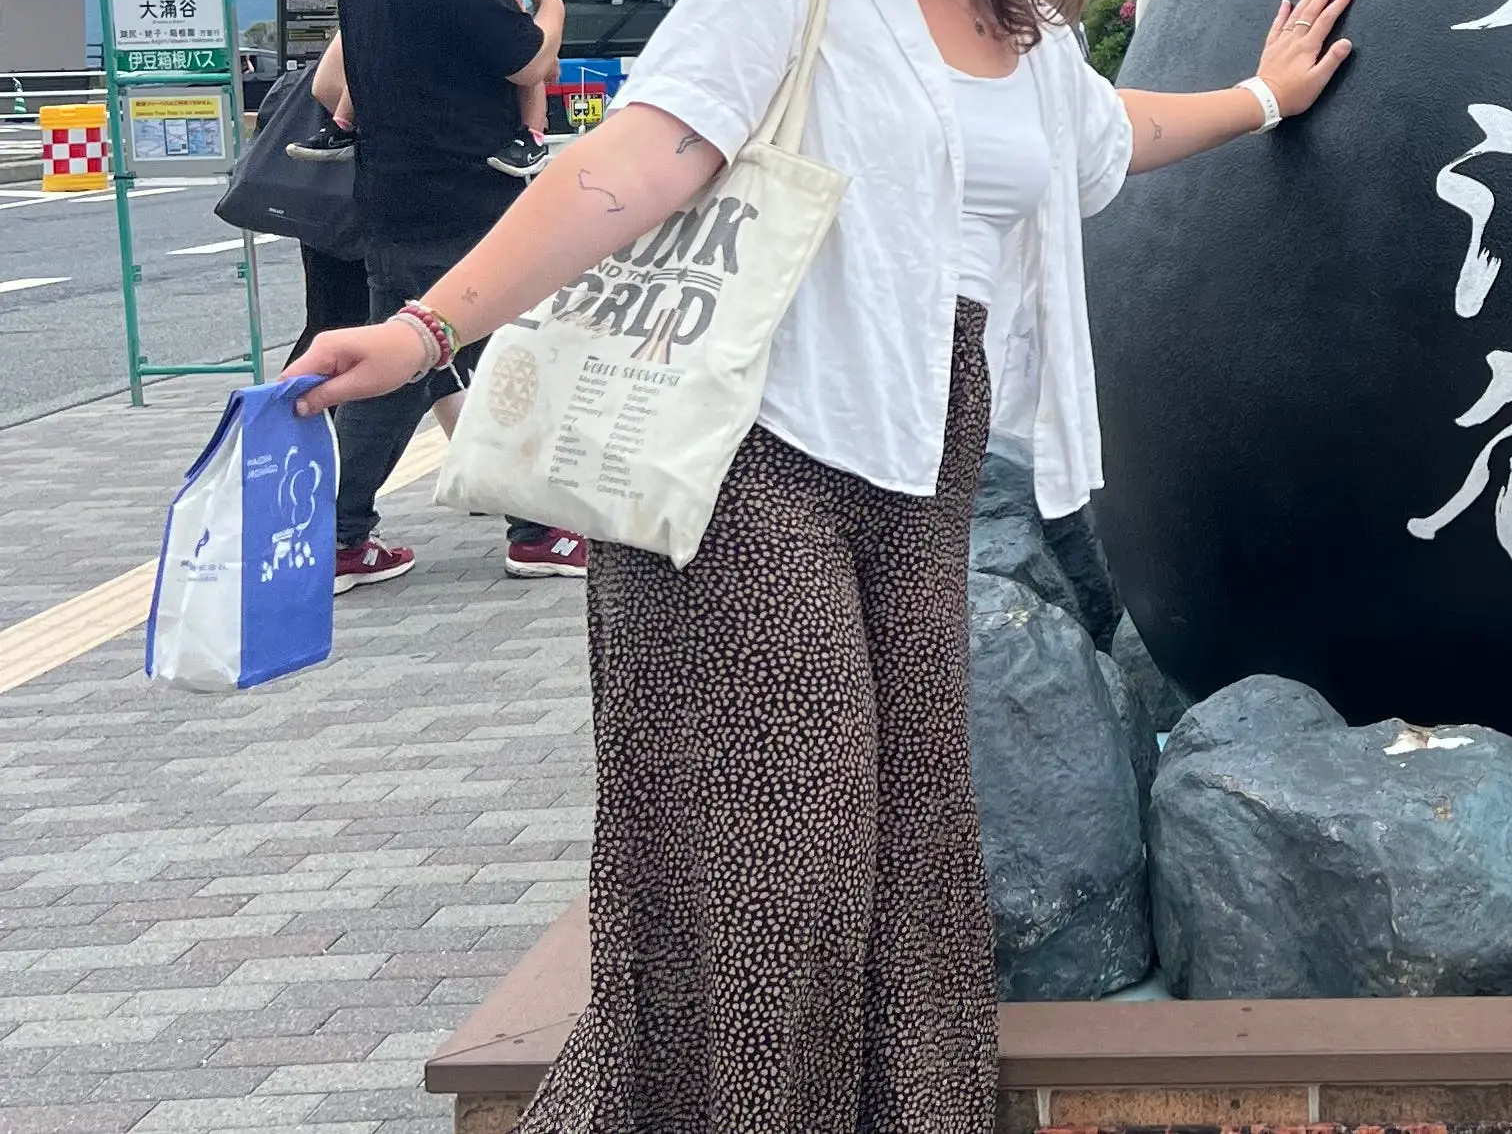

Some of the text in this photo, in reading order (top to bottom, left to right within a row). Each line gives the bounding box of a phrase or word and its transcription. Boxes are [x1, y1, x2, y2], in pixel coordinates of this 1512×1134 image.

[140, 0, 197, 19] 大涌谷
[128, 51, 215, 69] 伊豆箱根バス
[612, 197, 759, 275] INK
[598, 263, 622, 278] ND
[552, 273, 716, 345] ORLD
[551, 537, 578, 556] N
[362, 548, 378, 566] N
